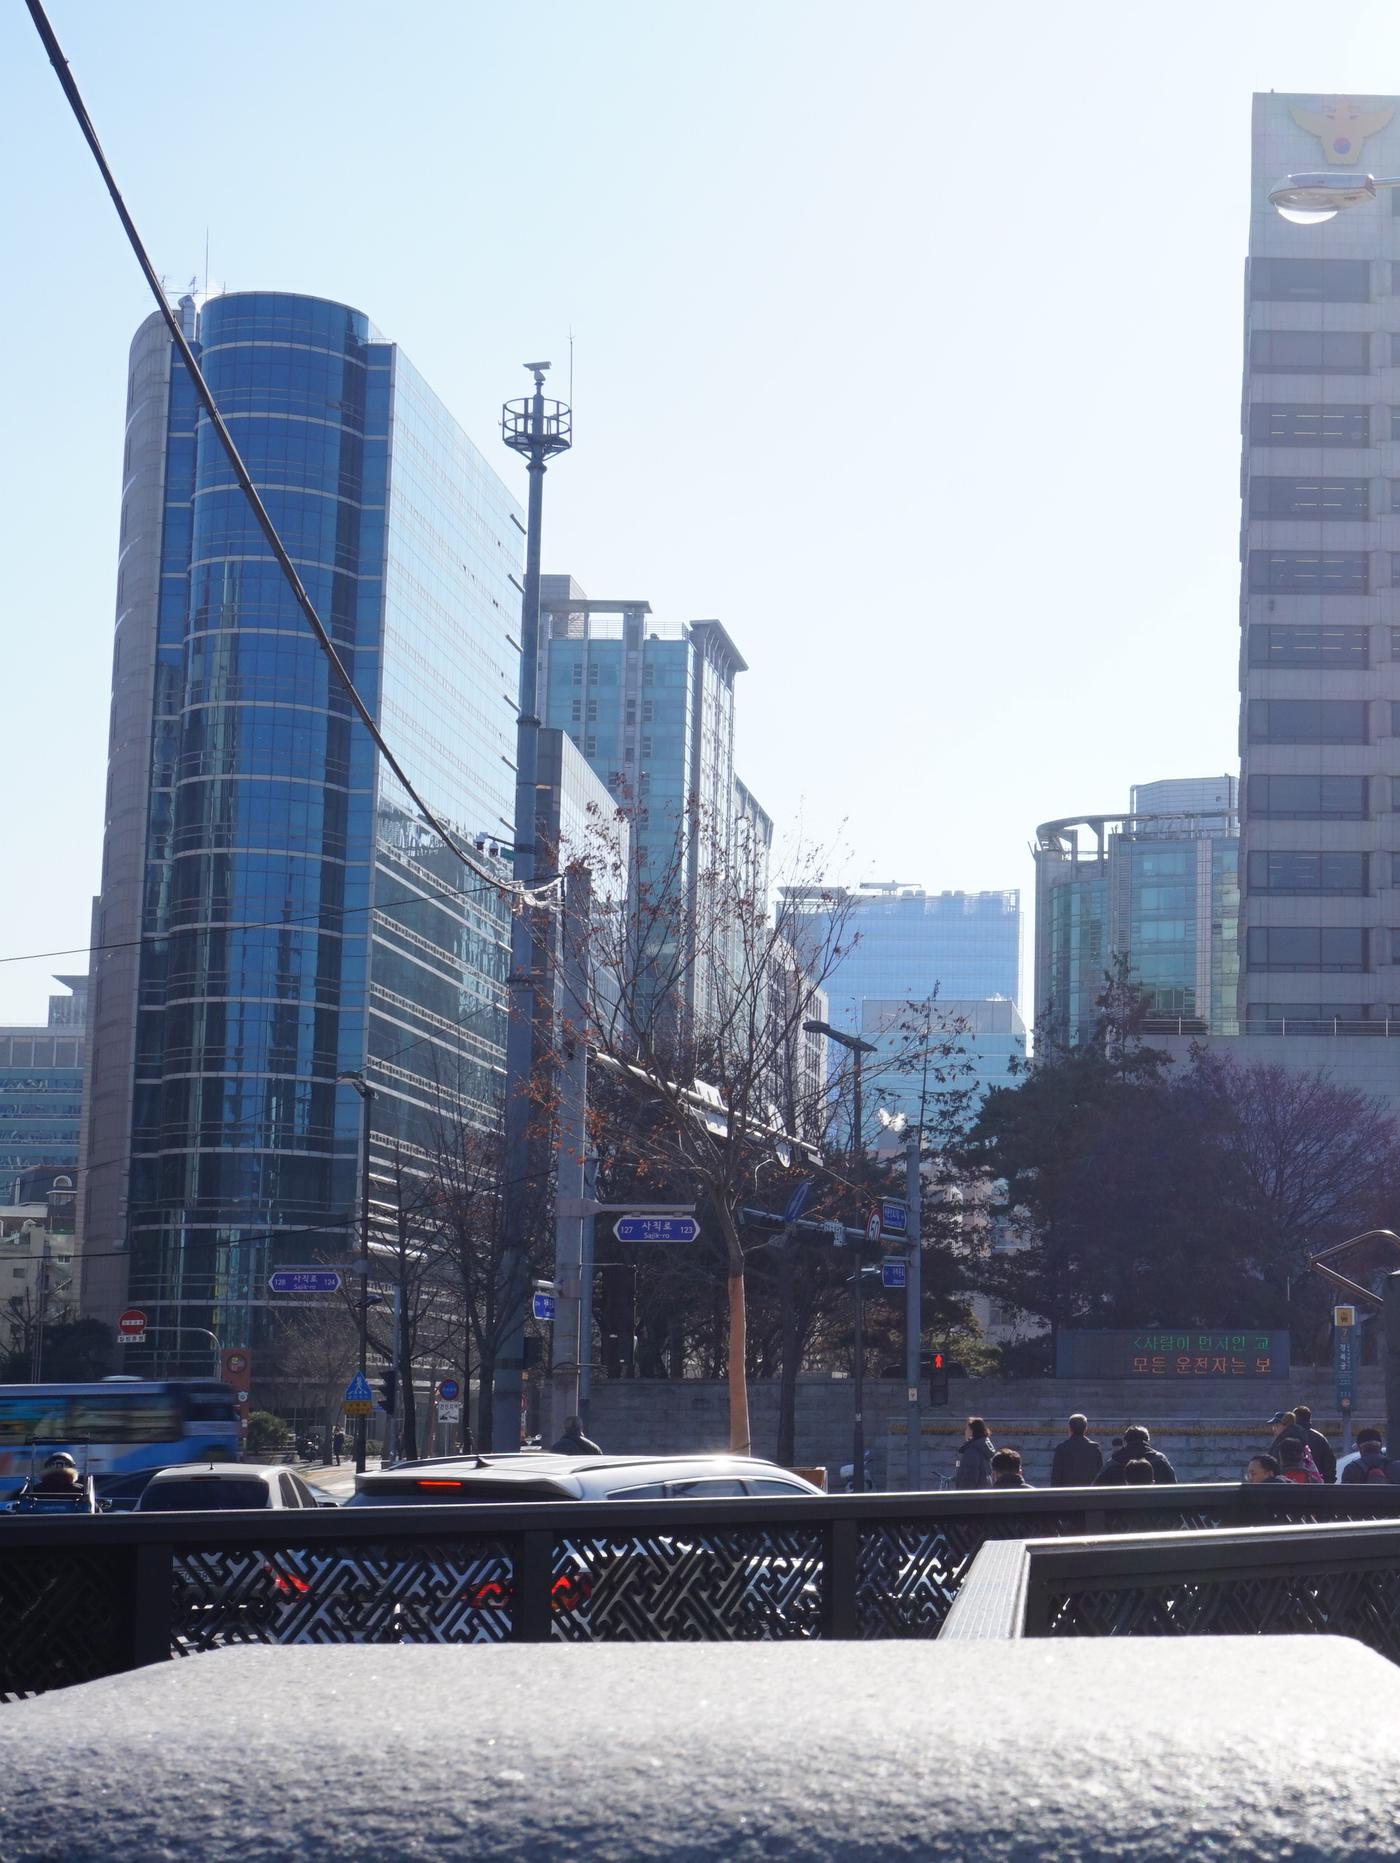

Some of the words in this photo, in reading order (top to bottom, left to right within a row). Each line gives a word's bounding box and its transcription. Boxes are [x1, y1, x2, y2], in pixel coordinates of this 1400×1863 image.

[621, 1226, 634, 1234] 127
[641, 1220, 673, 1232] 사직로
[680, 1226, 693, 1234] 123
[1132, 1356, 1167, 1374] 모든
[1176, 1355, 1246, 1374] 운전자는
[1255, 1357, 1271, 1373] 보
